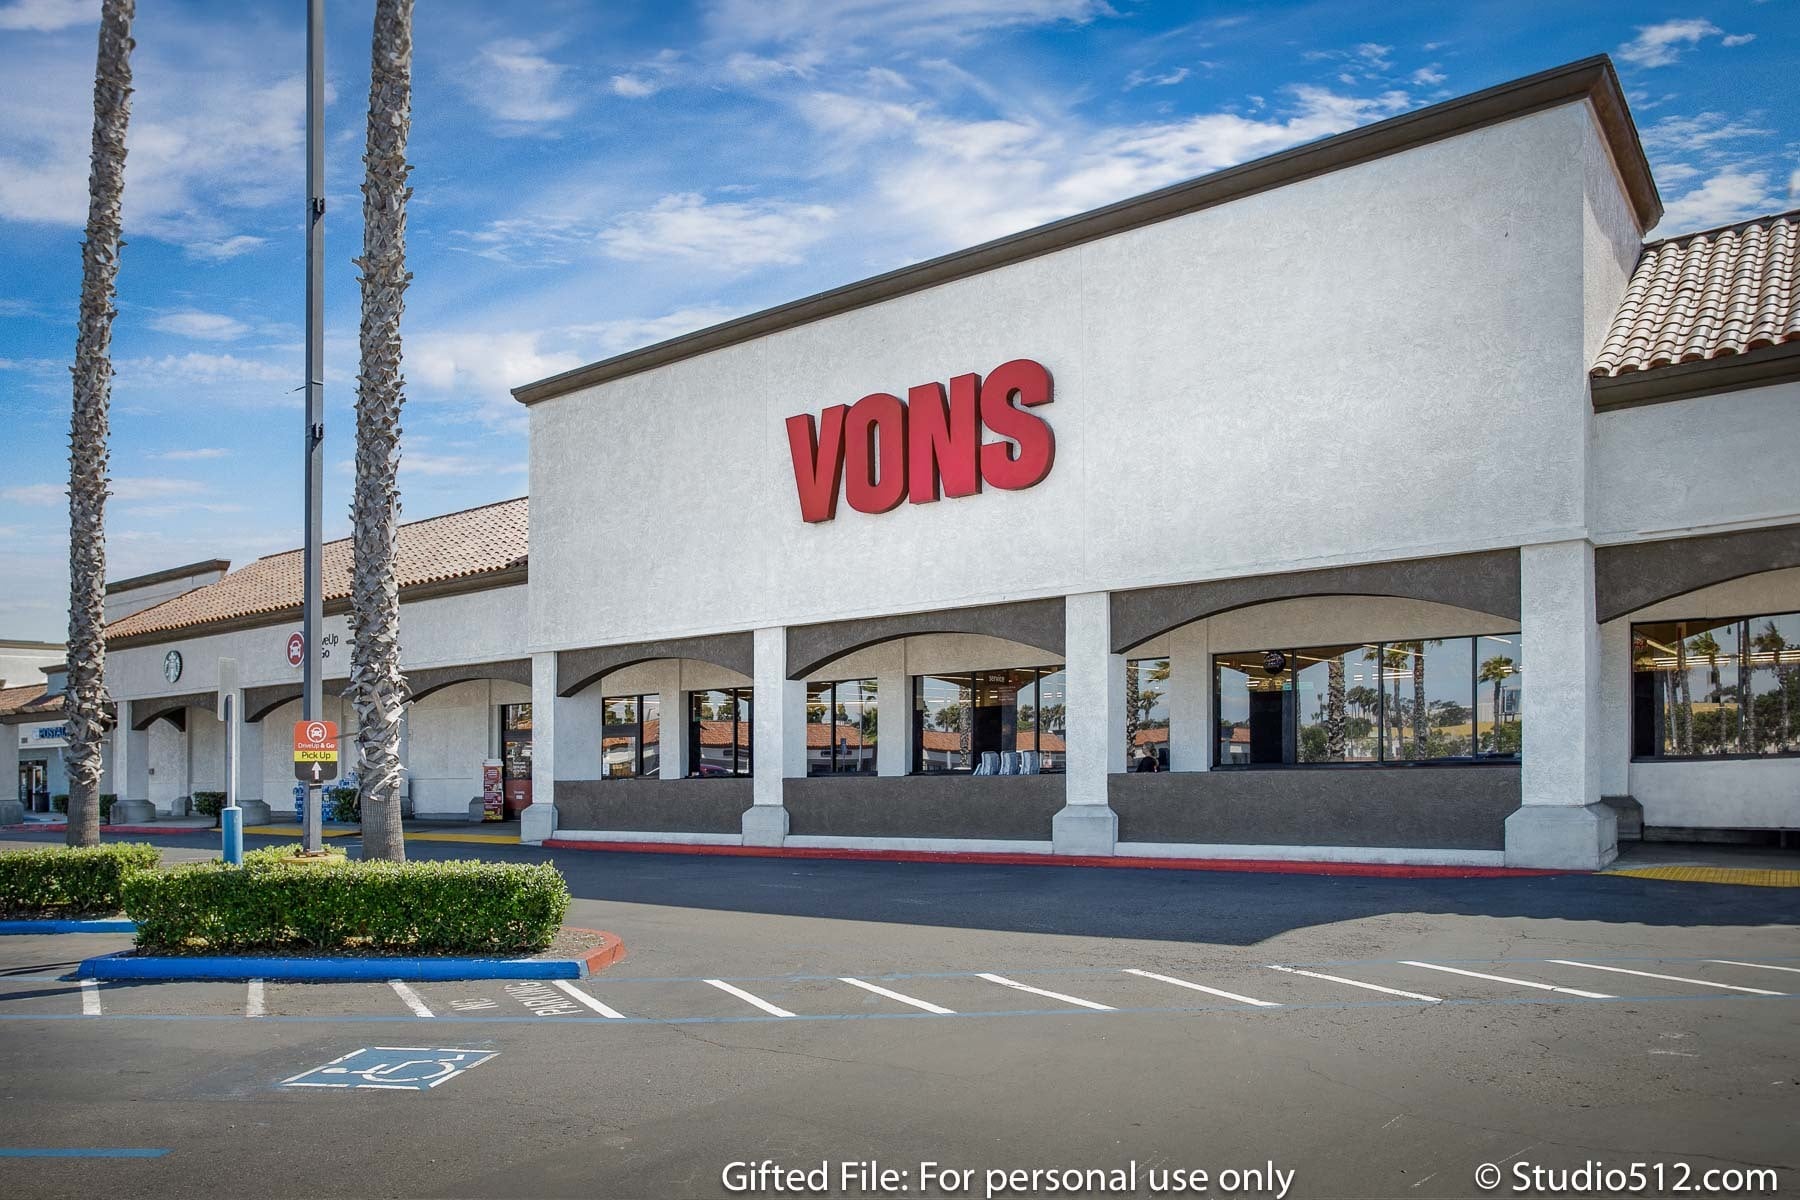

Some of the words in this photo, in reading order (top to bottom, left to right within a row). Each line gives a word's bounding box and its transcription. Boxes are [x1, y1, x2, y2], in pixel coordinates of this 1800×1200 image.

[785, 358, 1056, 523] VONS
[297, 742, 320, 750] DriveUp
[301, 751, 318, 759] Pick
[319, 751, 331, 760] Up
[503, 981, 583, 1017] PARKING
